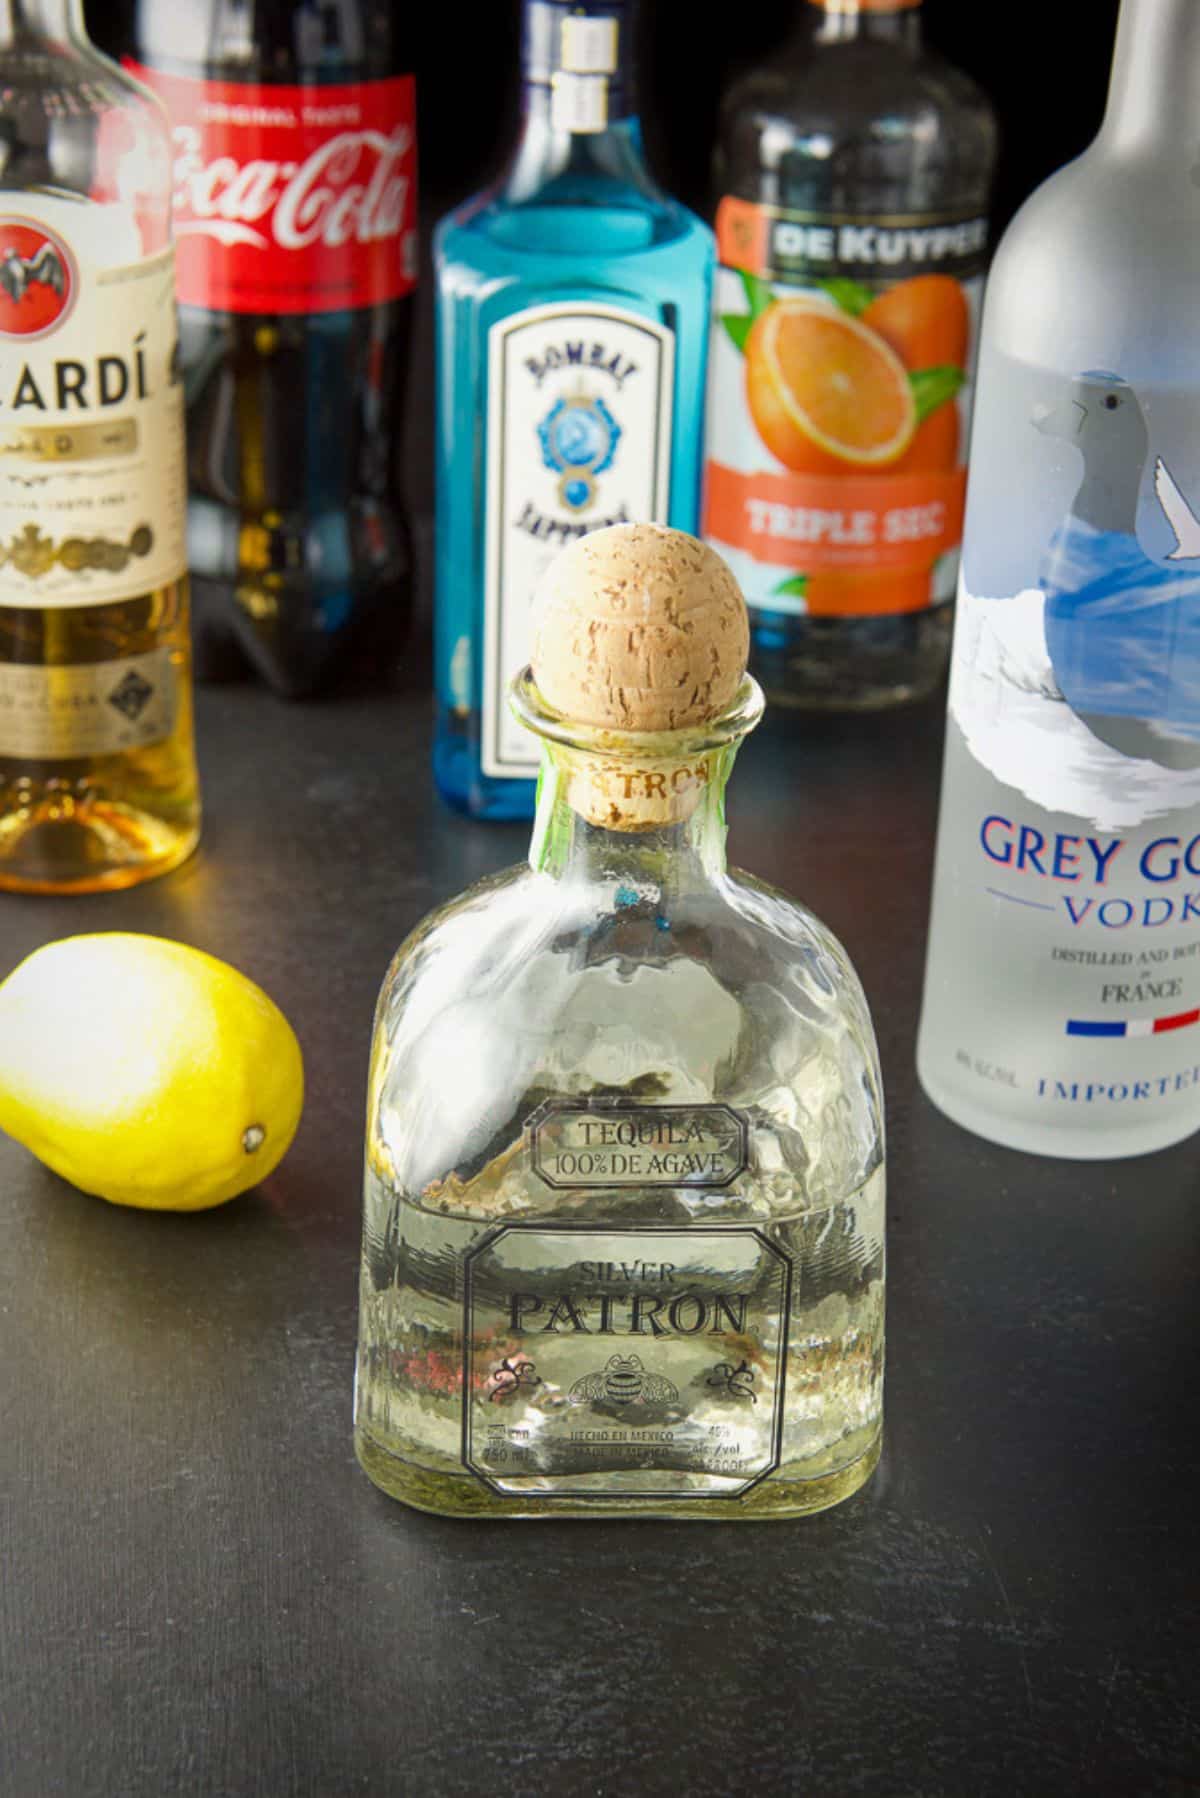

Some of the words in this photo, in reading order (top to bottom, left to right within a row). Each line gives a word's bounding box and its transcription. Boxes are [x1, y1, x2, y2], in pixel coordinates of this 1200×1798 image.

[774, 221, 834, 260] DE
[0, 330, 147, 410] ARDÍ
[524, 340, 638, 390] BOMBAY
[745, 498, 876, 544] TRIPLE
[883, 502, 945, 543] SEC
[980, 815, 1123, 885] GREY
[1051, 946, 1133, 966] DISTILLED
[1137, 949, 1169, 965] AND
[1100, 978, 1182, 1003] FRANCE
[578, 1121, 705, 1148] TEQUILA
[555, 1154, 607, 1175] 100%
[611, 1154, 642, 1175] DE
[646, 1152, 725, 1175] AGAVE
[579, 1260, 675, 1283] SILVER
